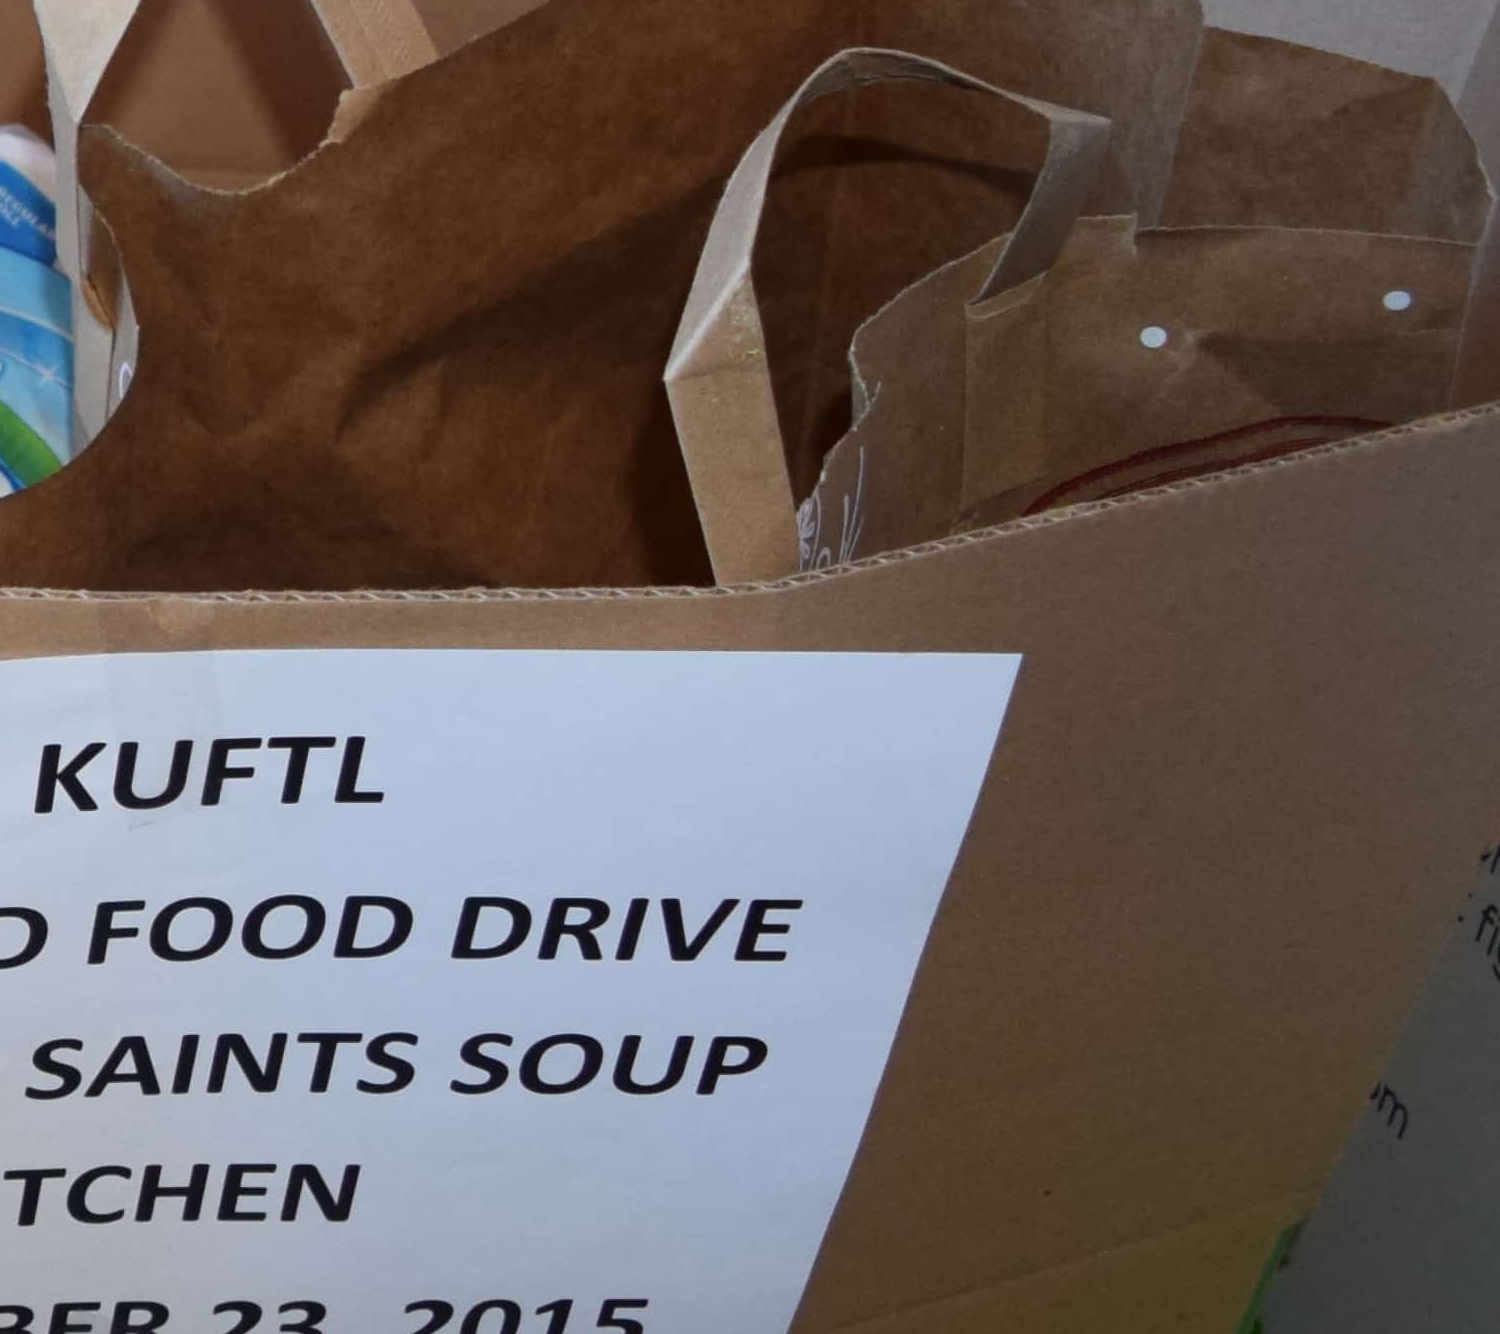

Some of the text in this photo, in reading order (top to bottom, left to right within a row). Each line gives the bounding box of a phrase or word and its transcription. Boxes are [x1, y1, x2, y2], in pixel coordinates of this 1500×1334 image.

[35, 737, 383, 813] KUFTL
[89, 896, 412, 963] FOOD
[452, 897, 802, 960] DRIVE
[26, 1033, 417, 1099] SAINTS
[451, 1034, 767, 1094] SOUP
